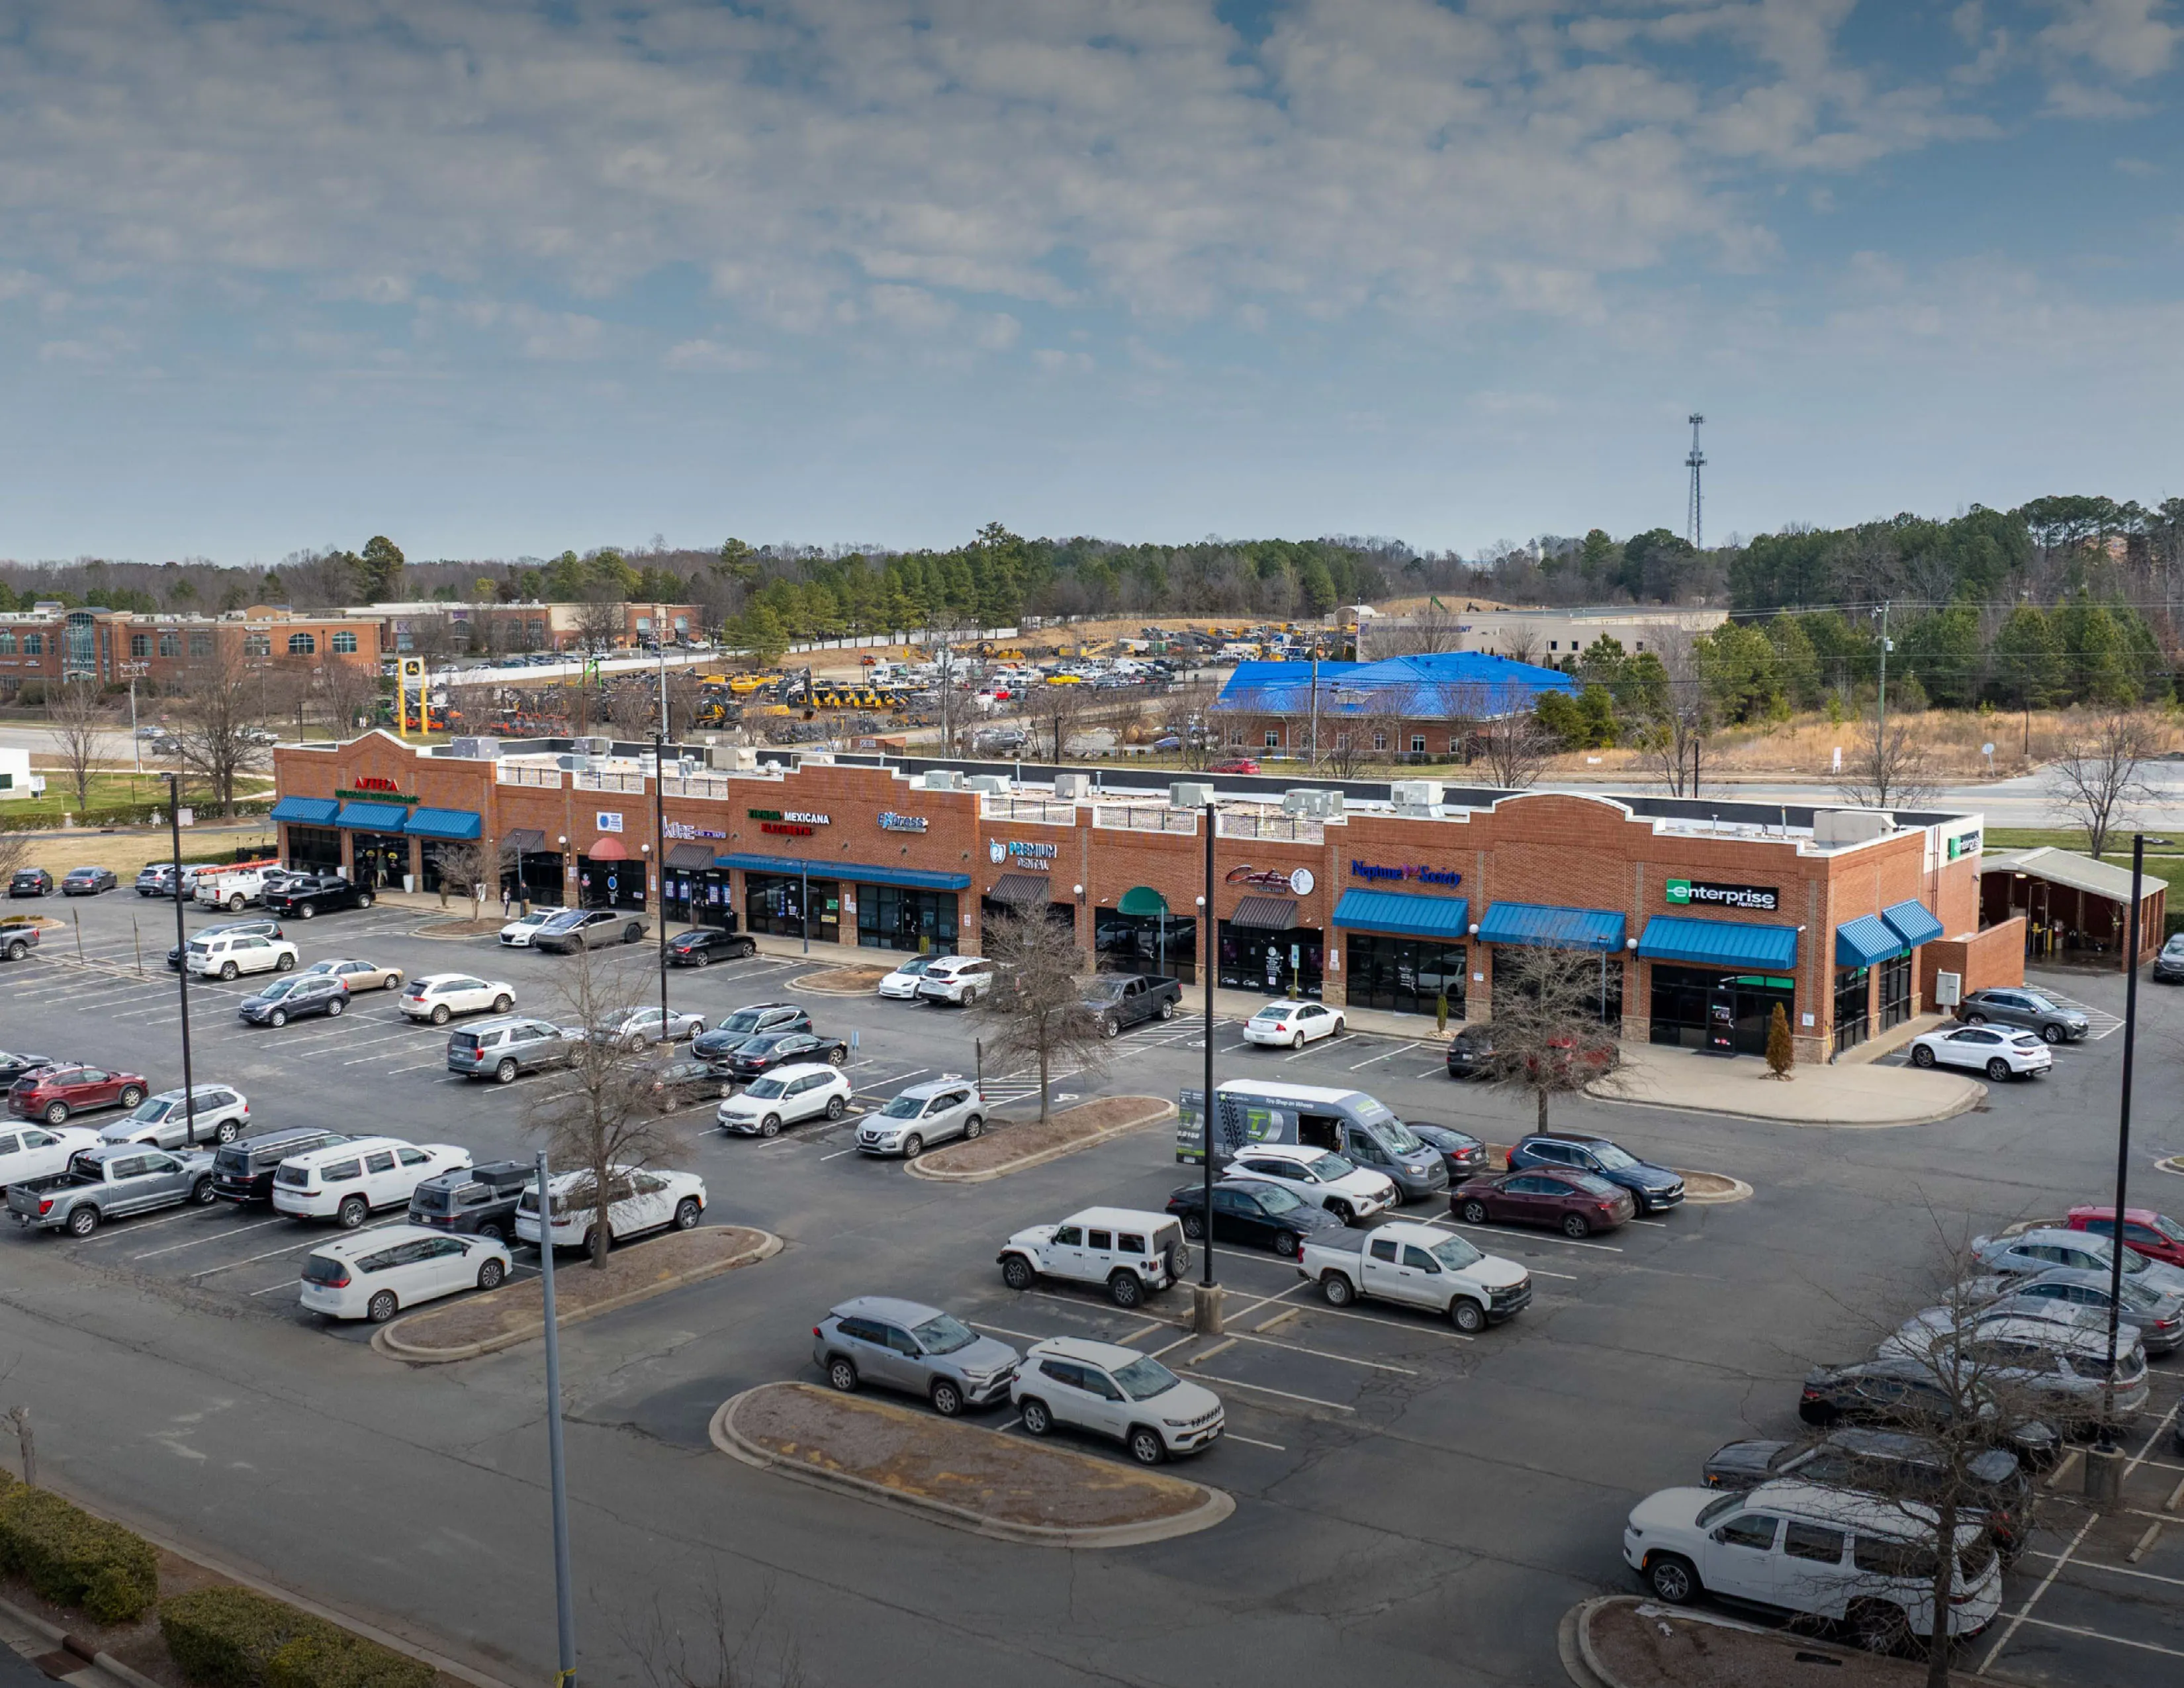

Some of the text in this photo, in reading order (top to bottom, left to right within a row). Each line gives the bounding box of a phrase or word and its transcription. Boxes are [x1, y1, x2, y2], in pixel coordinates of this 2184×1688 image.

[784, 811, 831, 825] MEXICANA
[1009, 841, 1057, 859] PREMIUM
[1017, 857, 1049, 870] DENTAL
[1351, 860, 1461, 889] Neptune Society
[1667, 886, 1775, 904] enterprise
[1737, 901, 1776, 910] rent-a-car
